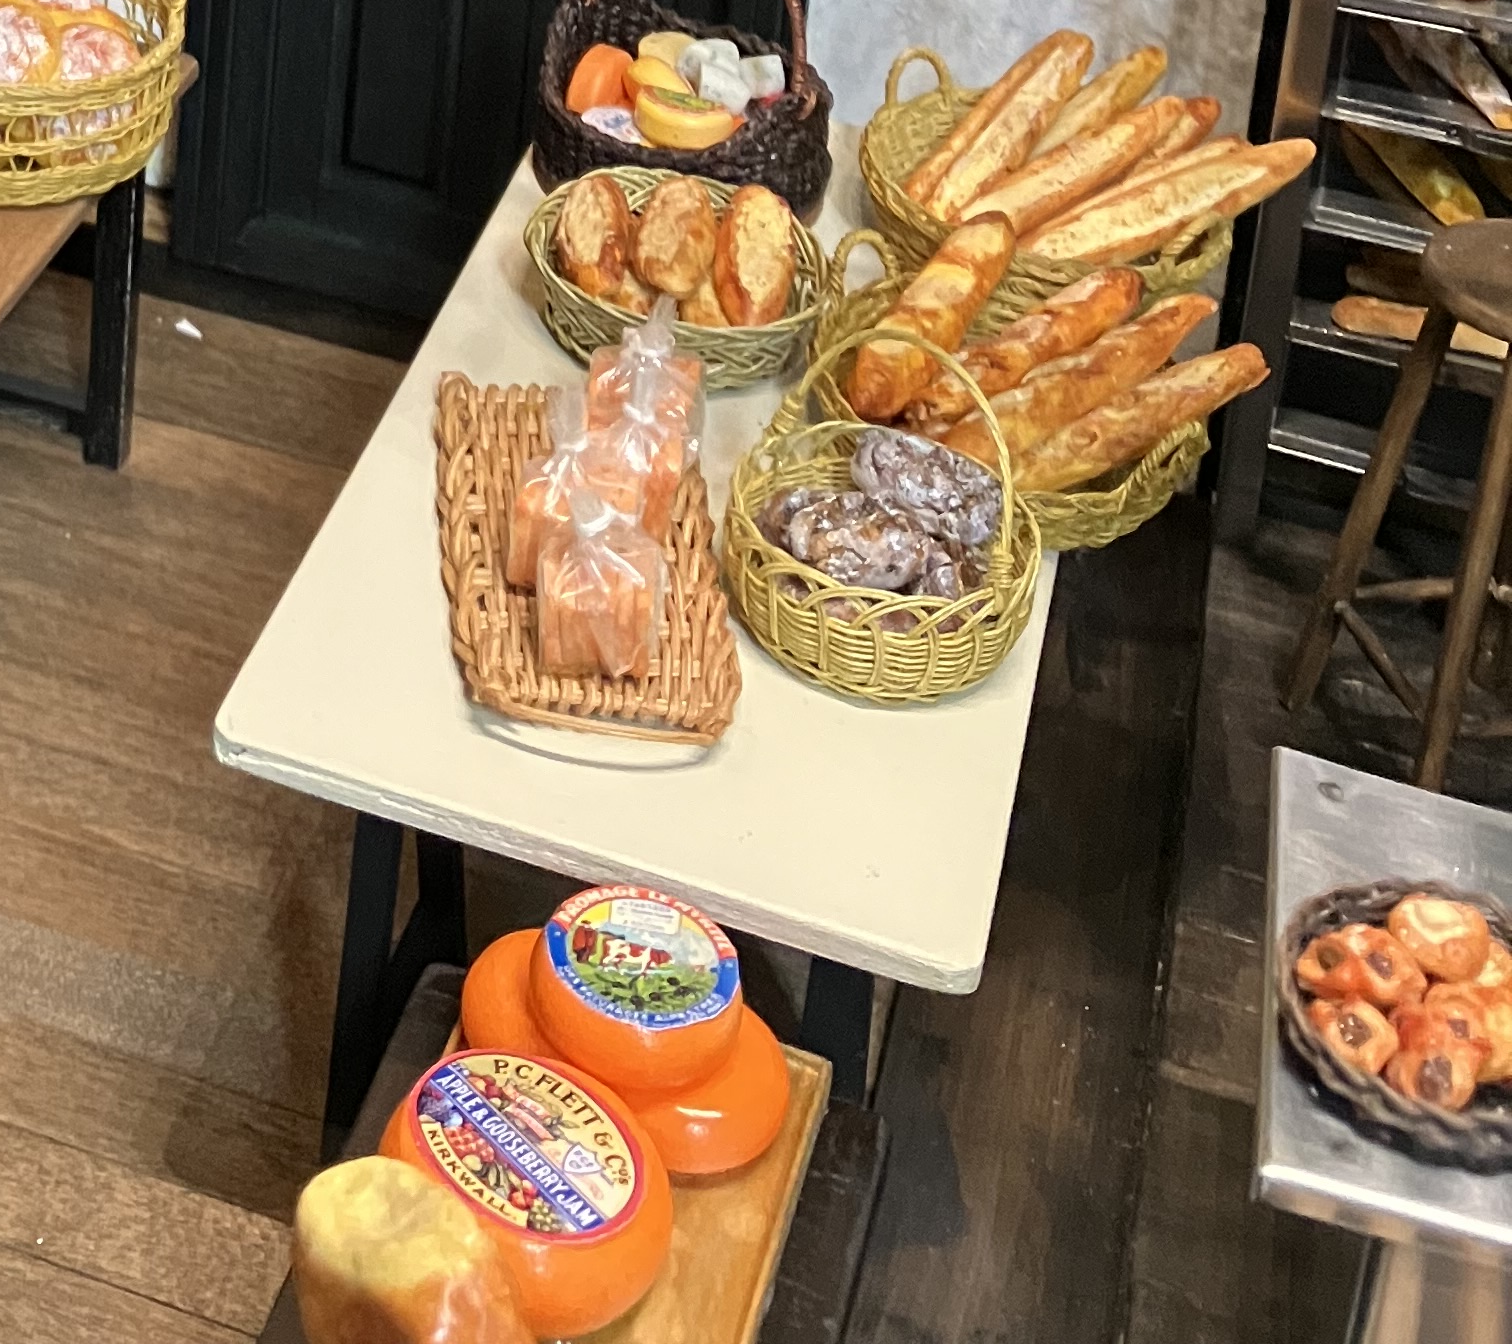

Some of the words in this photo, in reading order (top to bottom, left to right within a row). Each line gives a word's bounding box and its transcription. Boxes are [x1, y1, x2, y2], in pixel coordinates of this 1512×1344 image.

[557, 885, 639, 924] FROMAGE
[436, 1073, 483, 1111] APPLE
[471, 1107, 489, 1122] &
[482, 1116, 569, 1194] GOOSEBERRY
[556, 1194, 598, 1227] JAM
[535, 1073, 604, 1128] FLETT
[593, 1131, 613, 1150] &
